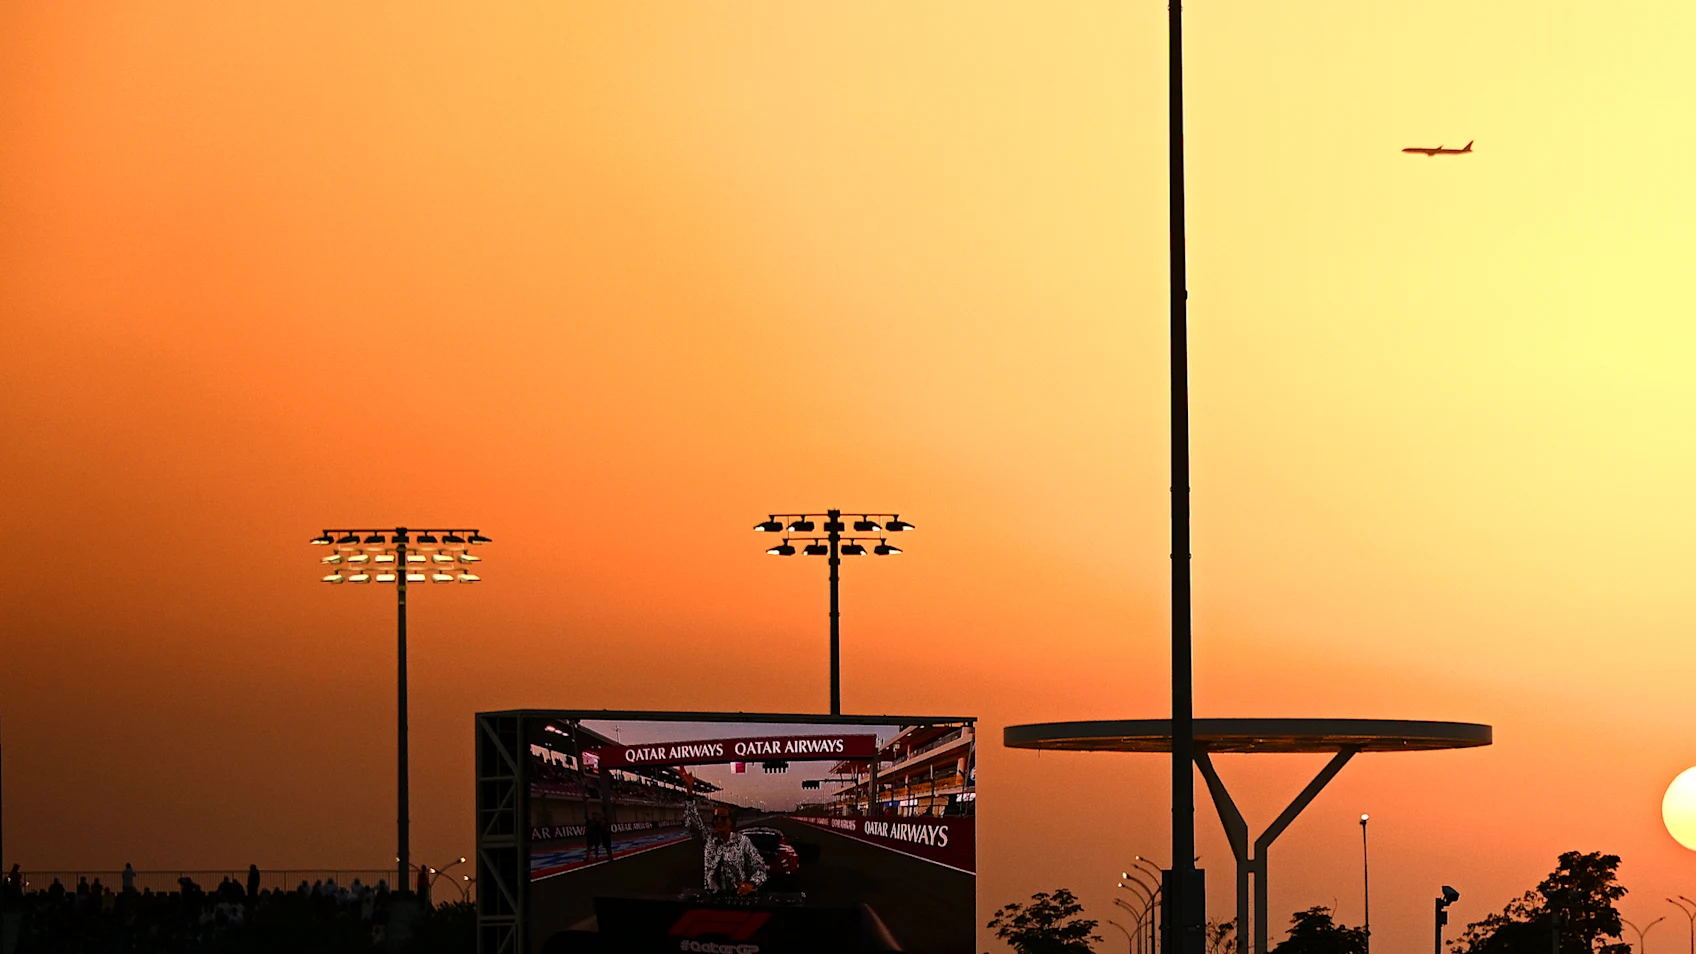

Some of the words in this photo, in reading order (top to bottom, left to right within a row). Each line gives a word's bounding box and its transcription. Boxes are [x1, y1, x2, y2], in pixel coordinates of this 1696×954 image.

[625, 746, 666, 763] QATAR
[669, 743, 724, 760] AIRWAYS
[734, 740, 782, 757] QATAR
[784, 738, 844, 754] AIRWAYS
[864, 820, 889, 838] QATAR
[889, 823, 949, 848] AIRWAYS
